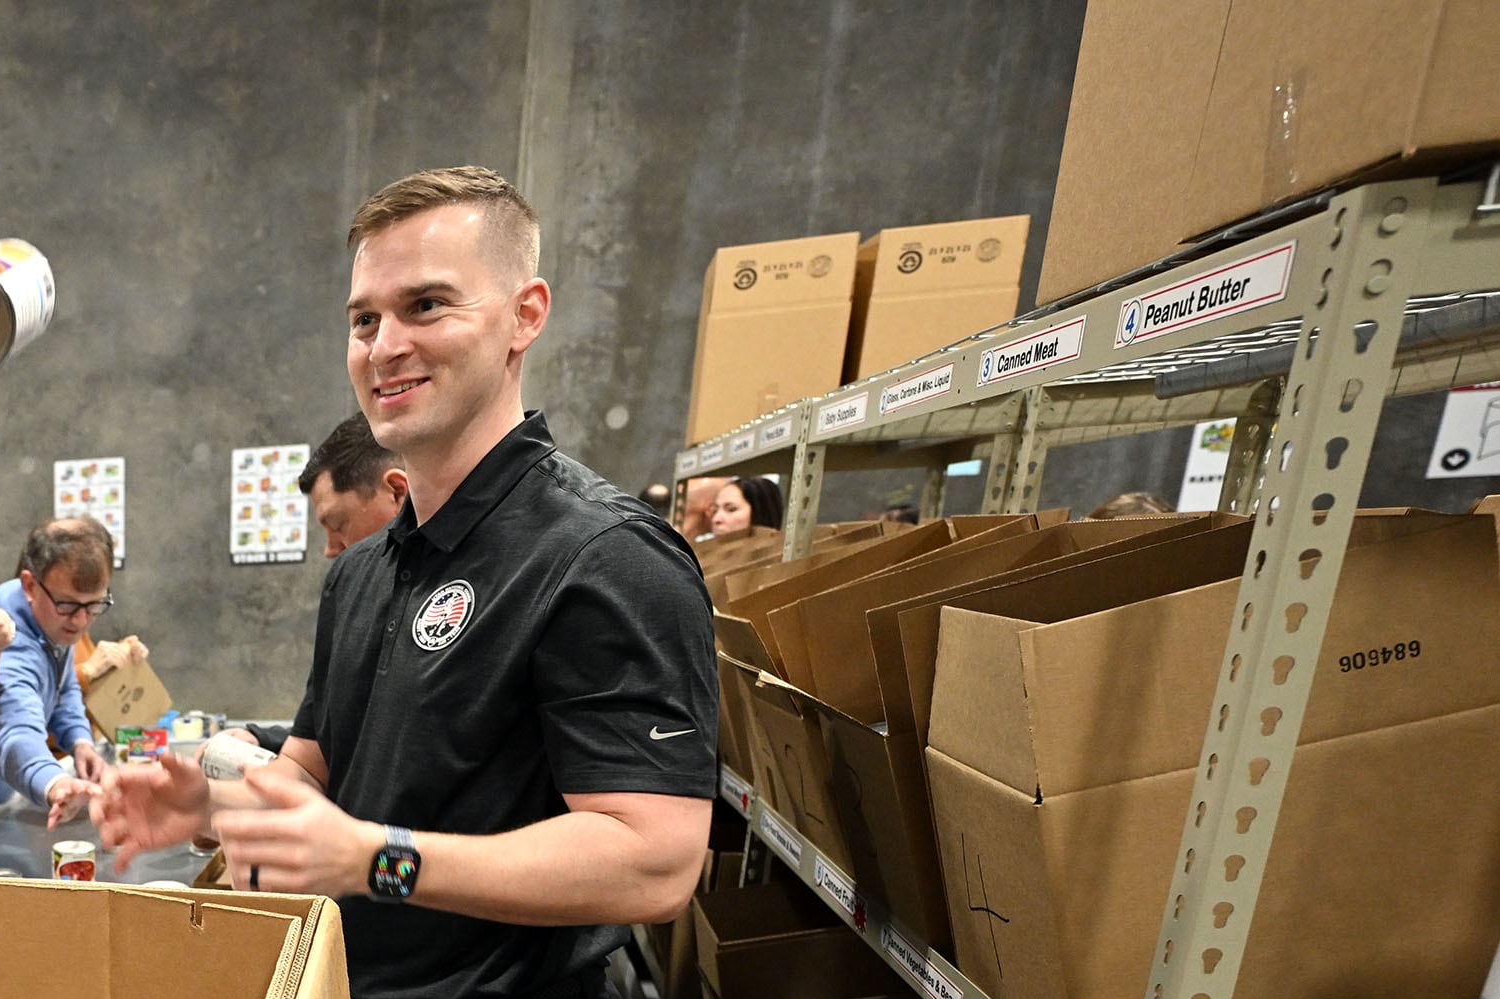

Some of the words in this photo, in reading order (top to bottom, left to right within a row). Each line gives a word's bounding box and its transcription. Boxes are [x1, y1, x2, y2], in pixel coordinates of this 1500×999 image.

[1125, 309, 1136, 334] 4
[1144, 290, 1195, 329] Peanut
[1197, 277, 1251, 312] Butter
[983, 357, 990, 378] 3
[997, 345, 1033, 373] Canned
[1034, 337, 1059, 363] Meat
[837, 406, 858, 422] Supplies
[1339, 640, 1421, 673] 684606
[823, 873, 842, 900] Canned
[962, 832, 1010, 979] 4
[906, 951, 935, 988] Vegetables
[935, 980, 940, 993] &
